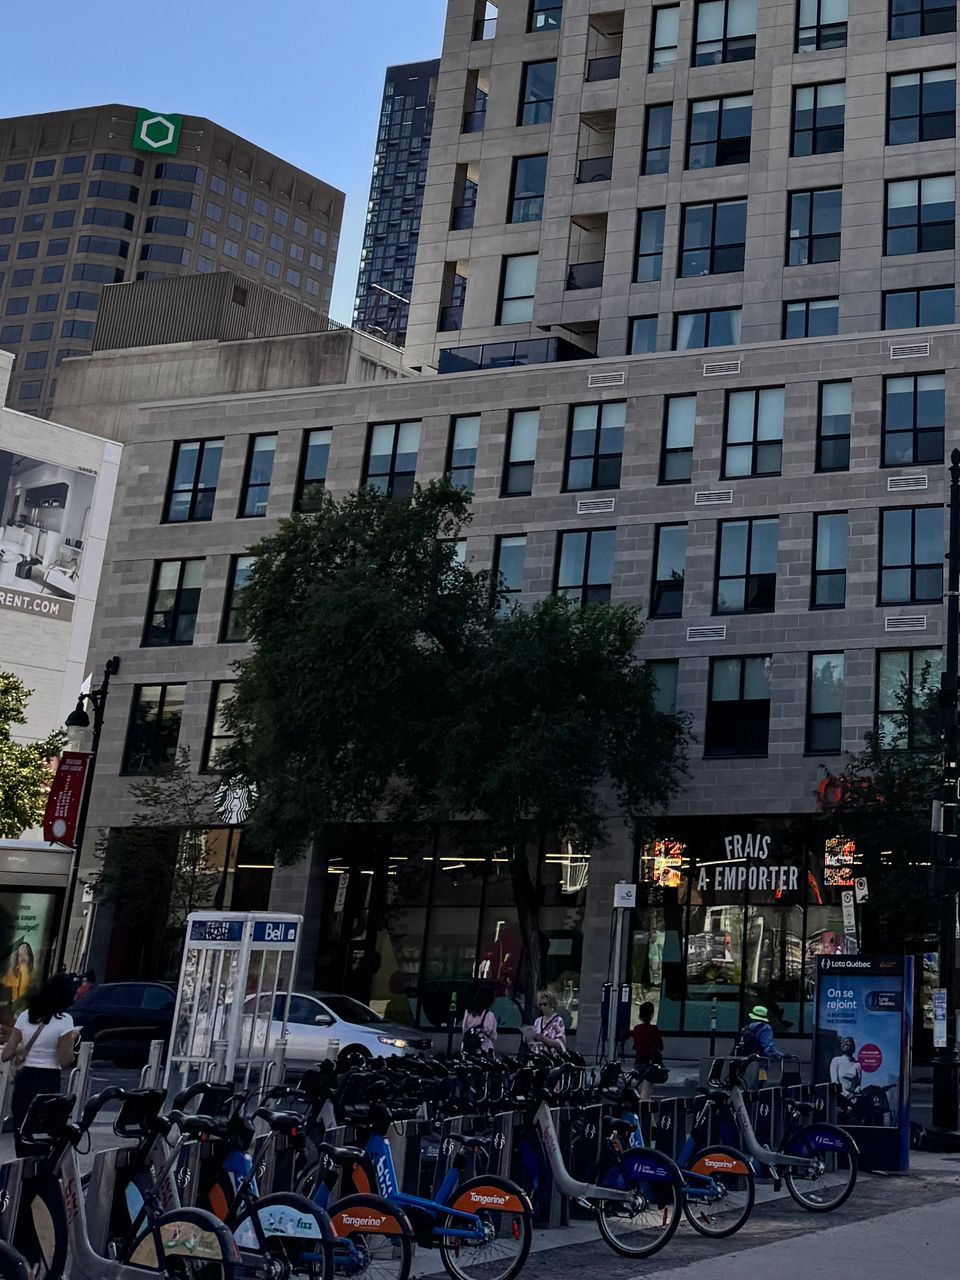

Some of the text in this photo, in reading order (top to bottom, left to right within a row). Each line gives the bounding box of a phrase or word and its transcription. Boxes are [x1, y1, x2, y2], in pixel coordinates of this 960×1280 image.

[0, 591, 59, 615] RENT.COM
[724, 833, 771, 859] FRAIS
[714, 866, 798, 890] EMPORTER
[264, 923, 285, 941] Bell
[846, 959, 871, 968] Québec
[827, 988, 854, 998] On se
[827, 999, 857, 1011] rejoint
[705, 1159, 733, 1169] Tangerine
[470, 1192, 505, 1205] Tangerine
[342, 1214, 381, 1227] Tangerine
